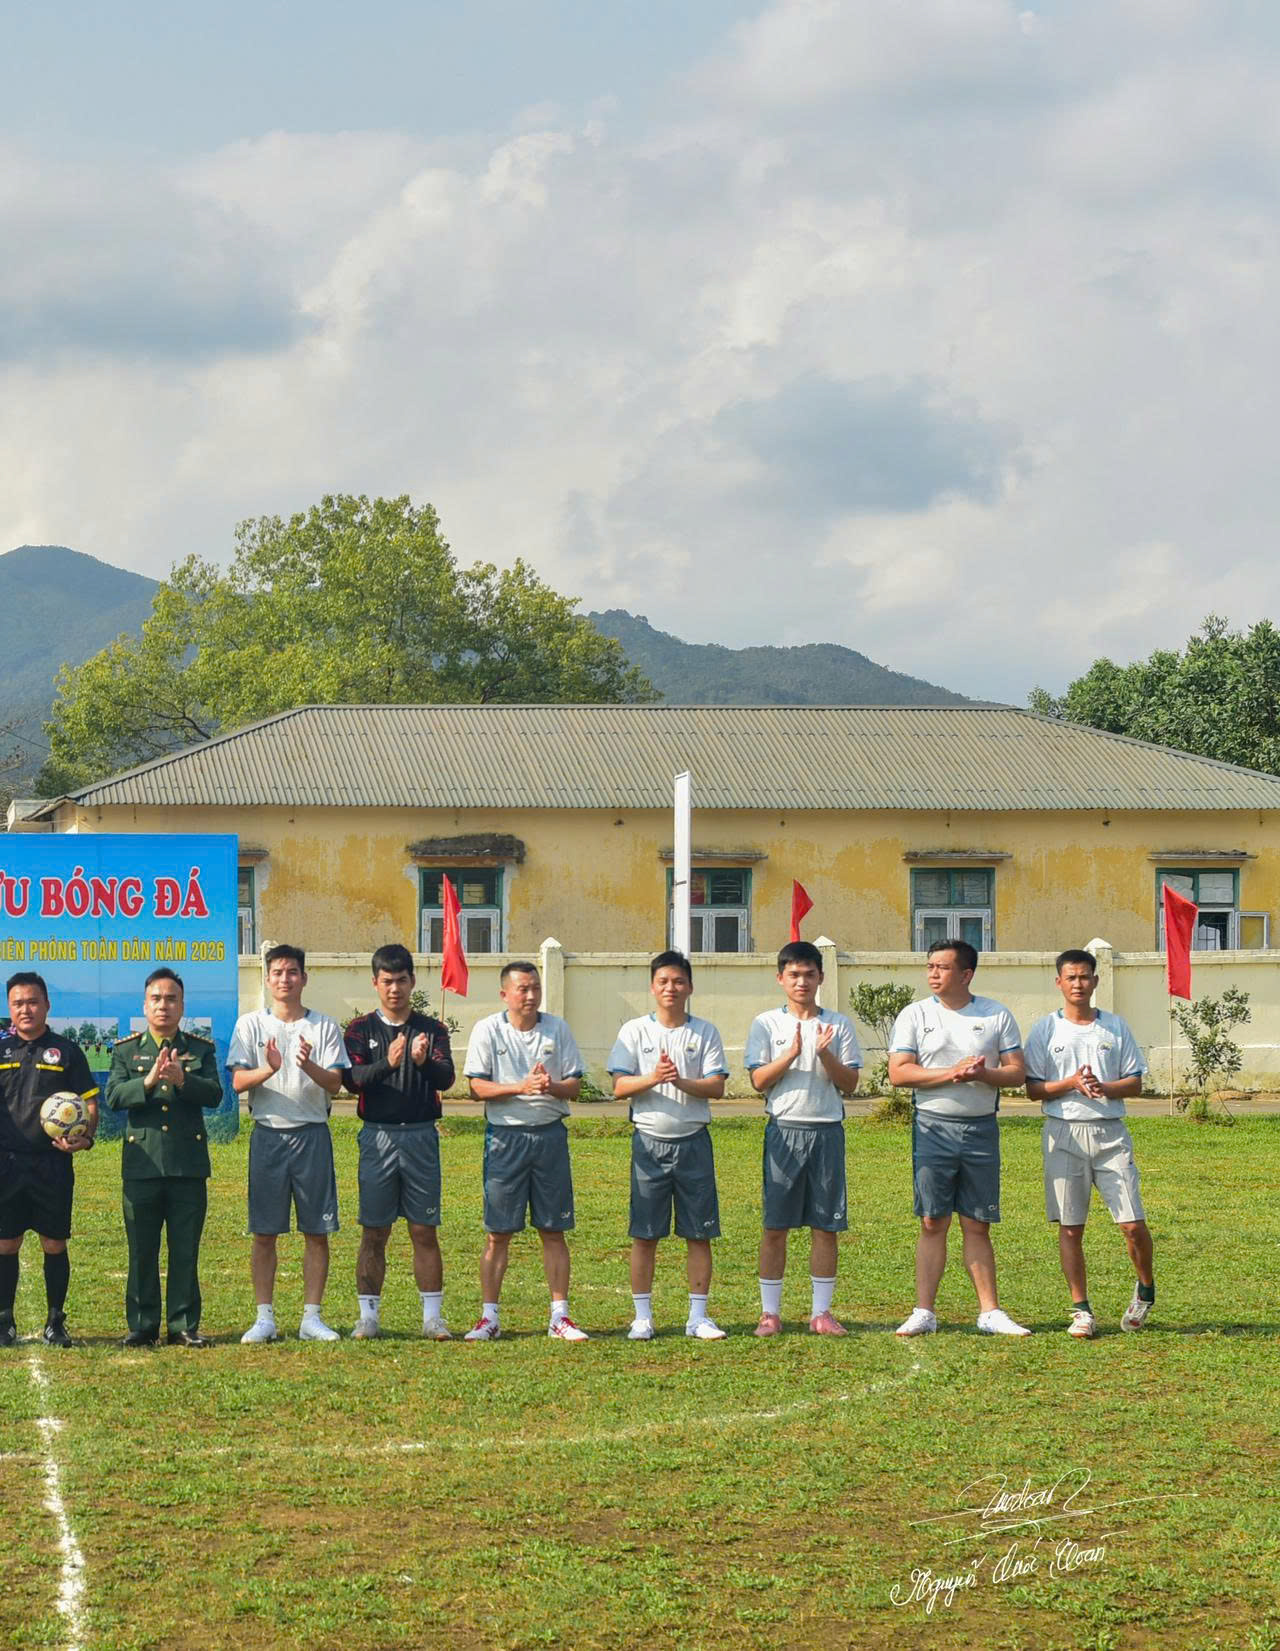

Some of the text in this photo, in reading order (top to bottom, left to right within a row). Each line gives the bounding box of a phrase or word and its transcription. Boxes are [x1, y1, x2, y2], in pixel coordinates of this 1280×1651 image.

[40, 865, 144, 917] BÓNG
[153, 867, 209, 917] ĐÁ
[81, 936, 118, 961] TOÀN
[122, 936, 151, 961] DÂN
[155, 936, 187, 961] NĂM
[191, 941, 225, 961] 2026
